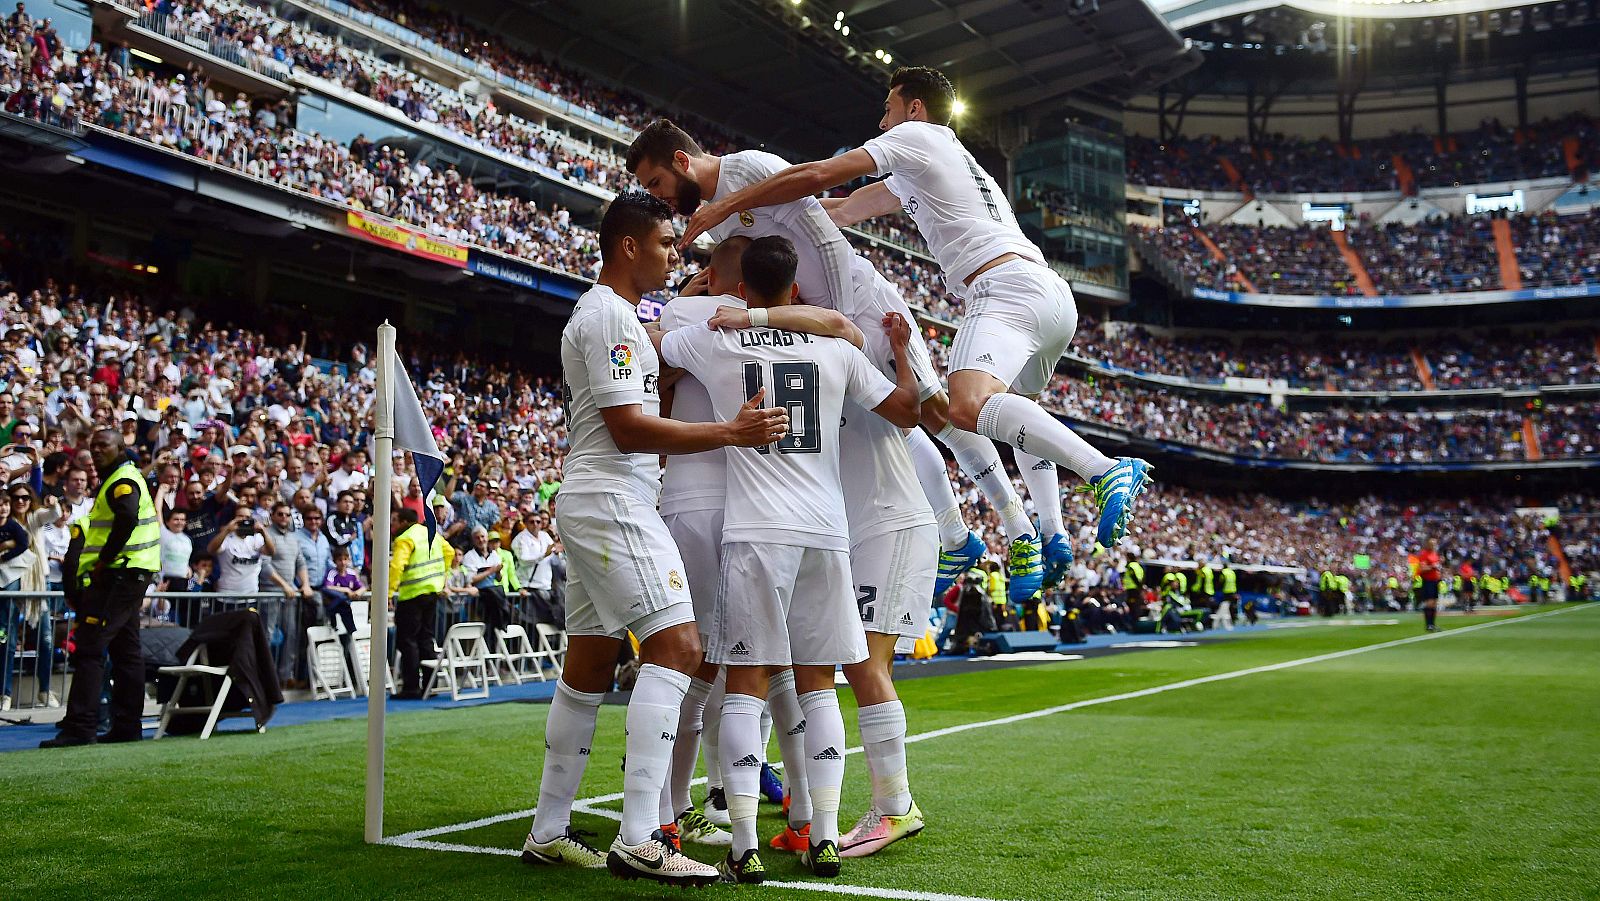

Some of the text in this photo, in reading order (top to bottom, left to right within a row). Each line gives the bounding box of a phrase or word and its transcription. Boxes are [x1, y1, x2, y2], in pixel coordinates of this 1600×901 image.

[476, 259, 533, 285] Real Madrid
[739, 330, 794, 347] LUCAS
[612, 368, 632, 380] LFP
[741, 360, 822, 454] 18
[973, 459, 998, 482] RMCF
